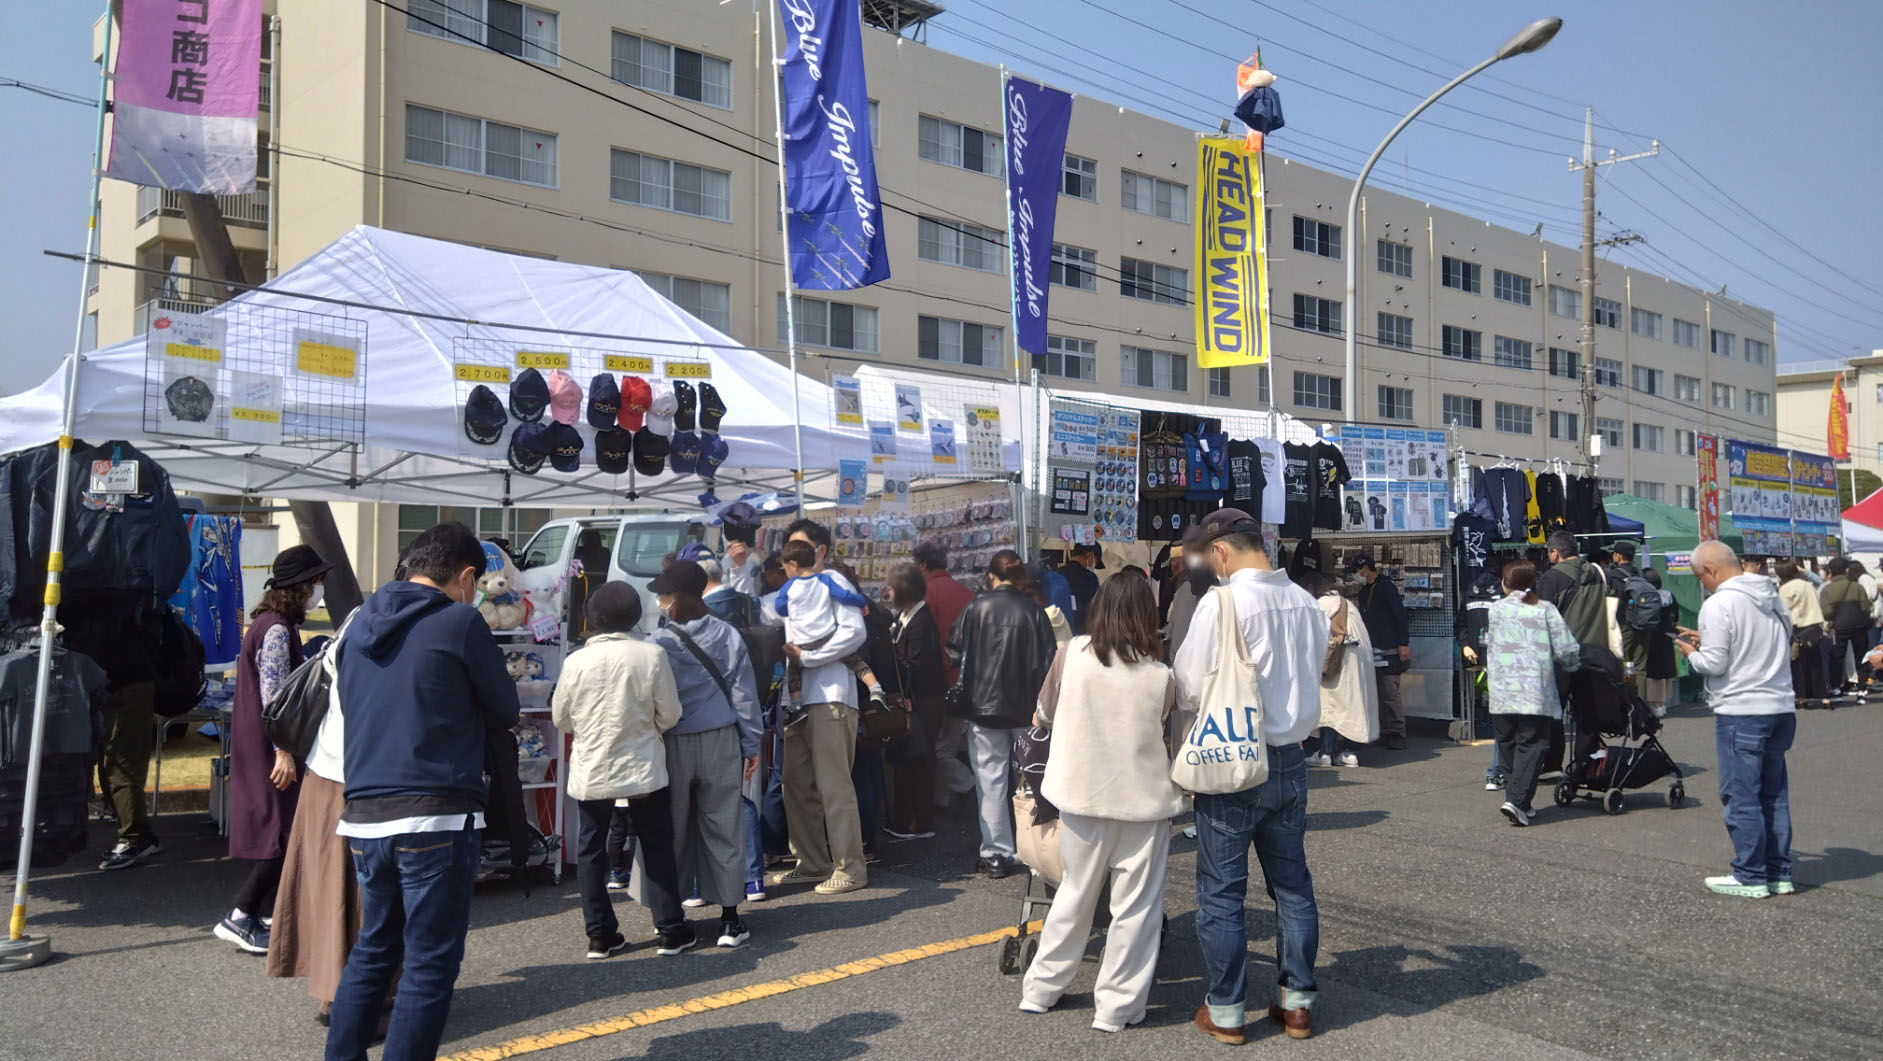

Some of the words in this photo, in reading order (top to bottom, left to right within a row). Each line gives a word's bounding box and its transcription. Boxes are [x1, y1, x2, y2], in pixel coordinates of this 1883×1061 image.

[784, 0, 822, 81] Blue
[818, 94, 877, 238] Impulse
[1008, 84, 1029, 176] Blue
[1217, 150, 1247, 252] HEAD
[1018, 186, 1041, 319] Impulse
[1211, 256, 1242, 353] WIND
[1190, 707, 1258, 747] AL
